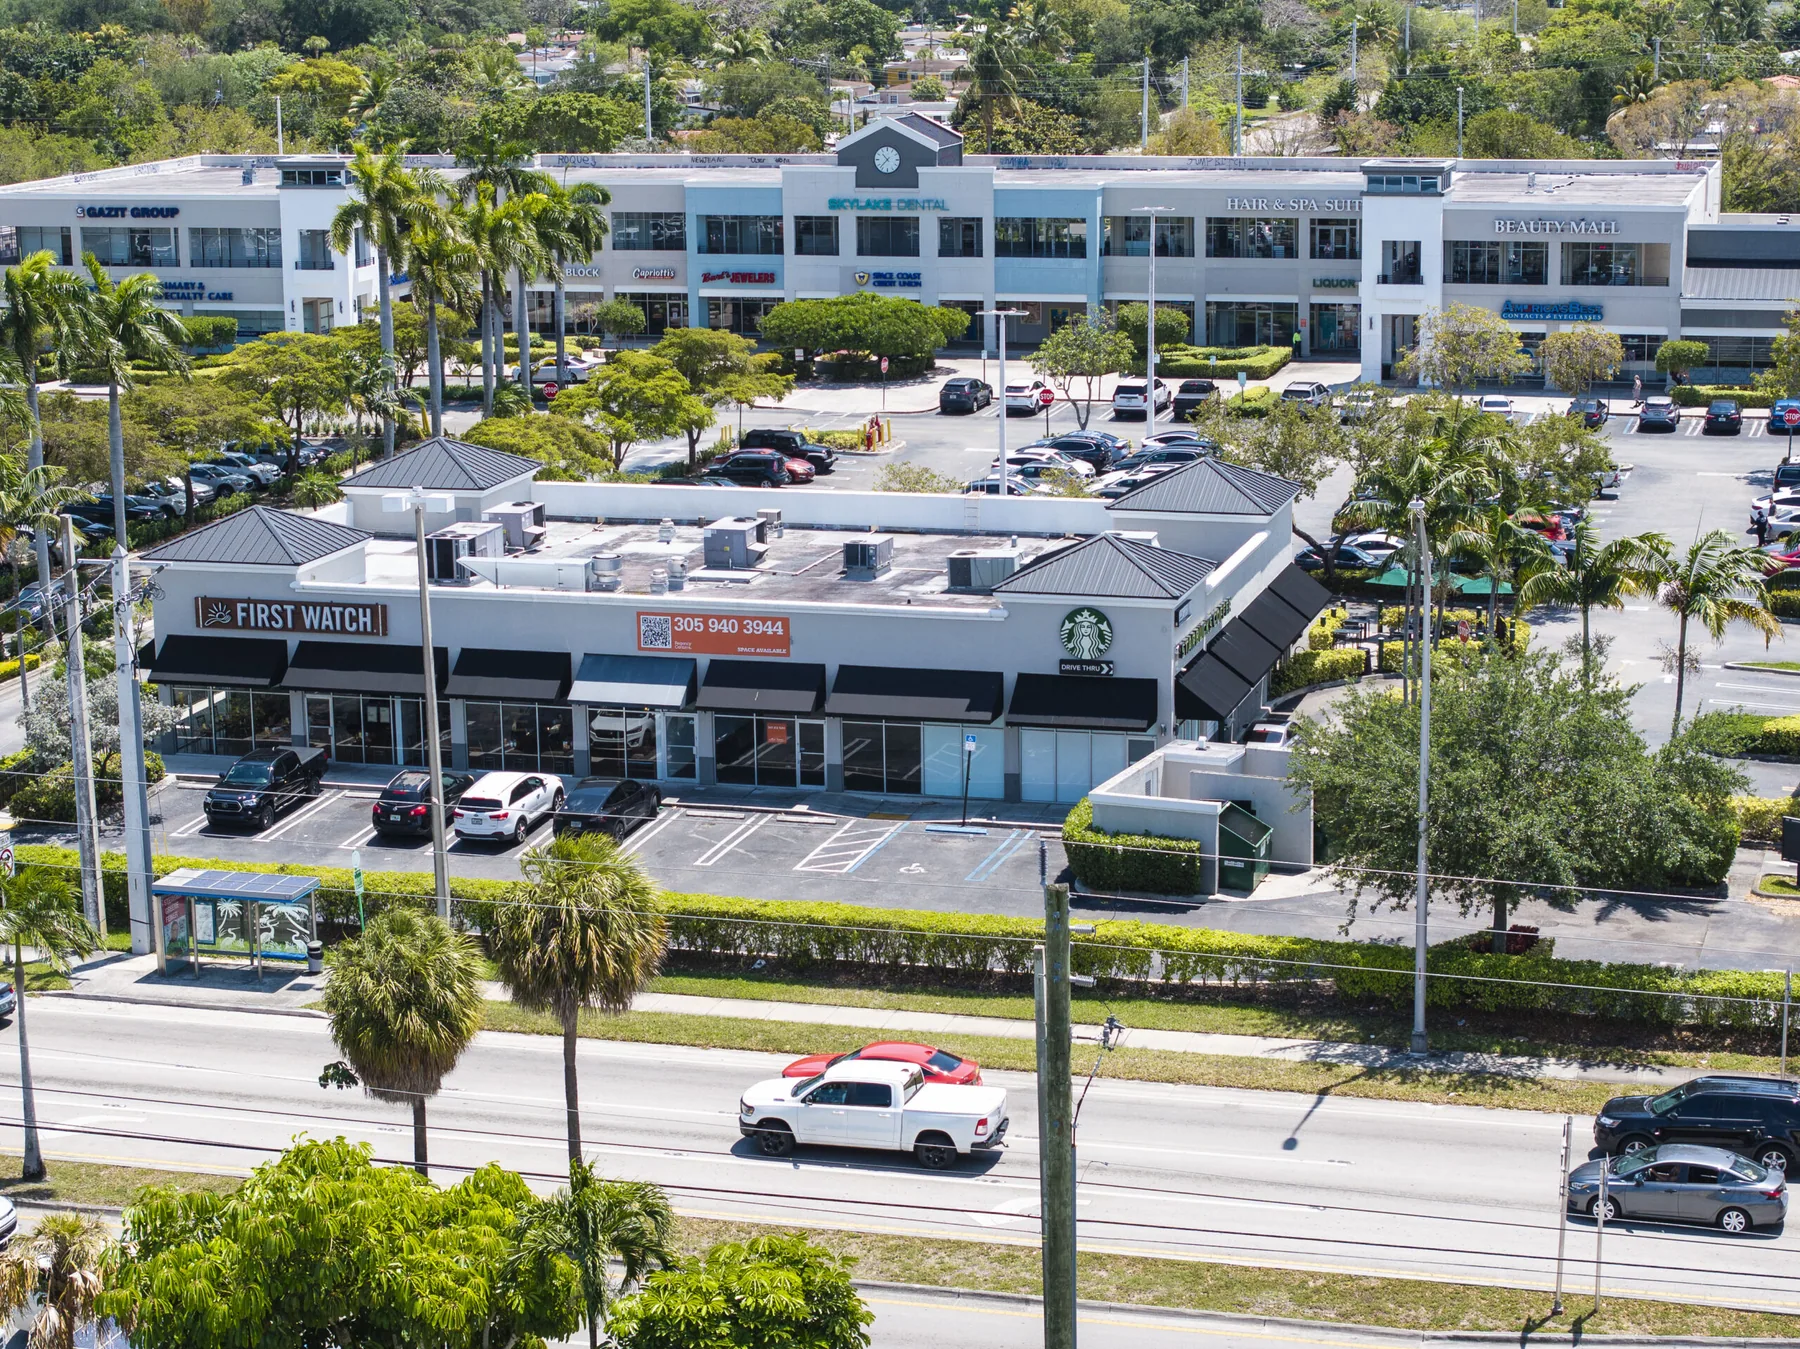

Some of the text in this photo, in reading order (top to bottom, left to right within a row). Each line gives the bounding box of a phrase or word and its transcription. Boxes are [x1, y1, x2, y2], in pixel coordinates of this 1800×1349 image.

[828, 198, 950, 211] SKYLAKE DENTAL
[1226, 198, 1268, 211] HAIR
[1273, 199, 1285, 211] &
[1289, 199, 1318, 211] SPA
[86, 207, 180, 218] GAZIT GROUP
[1494, 220, 1620, 235] BEAUTY MALL
[565, 268, 599, 277] BLOCK
[632, 267, 675, 279] Capriotti's
[730, 272, 775, 283] JEWELERS
[896, 272, 922, 280] COAST
[1312, 278, 1356, 288] LIQUOR
[208, 292, 233, 300] CARE
[236, 602, 295, 629] FIRST
[674, 617, 784, 635] 305 940 3944
